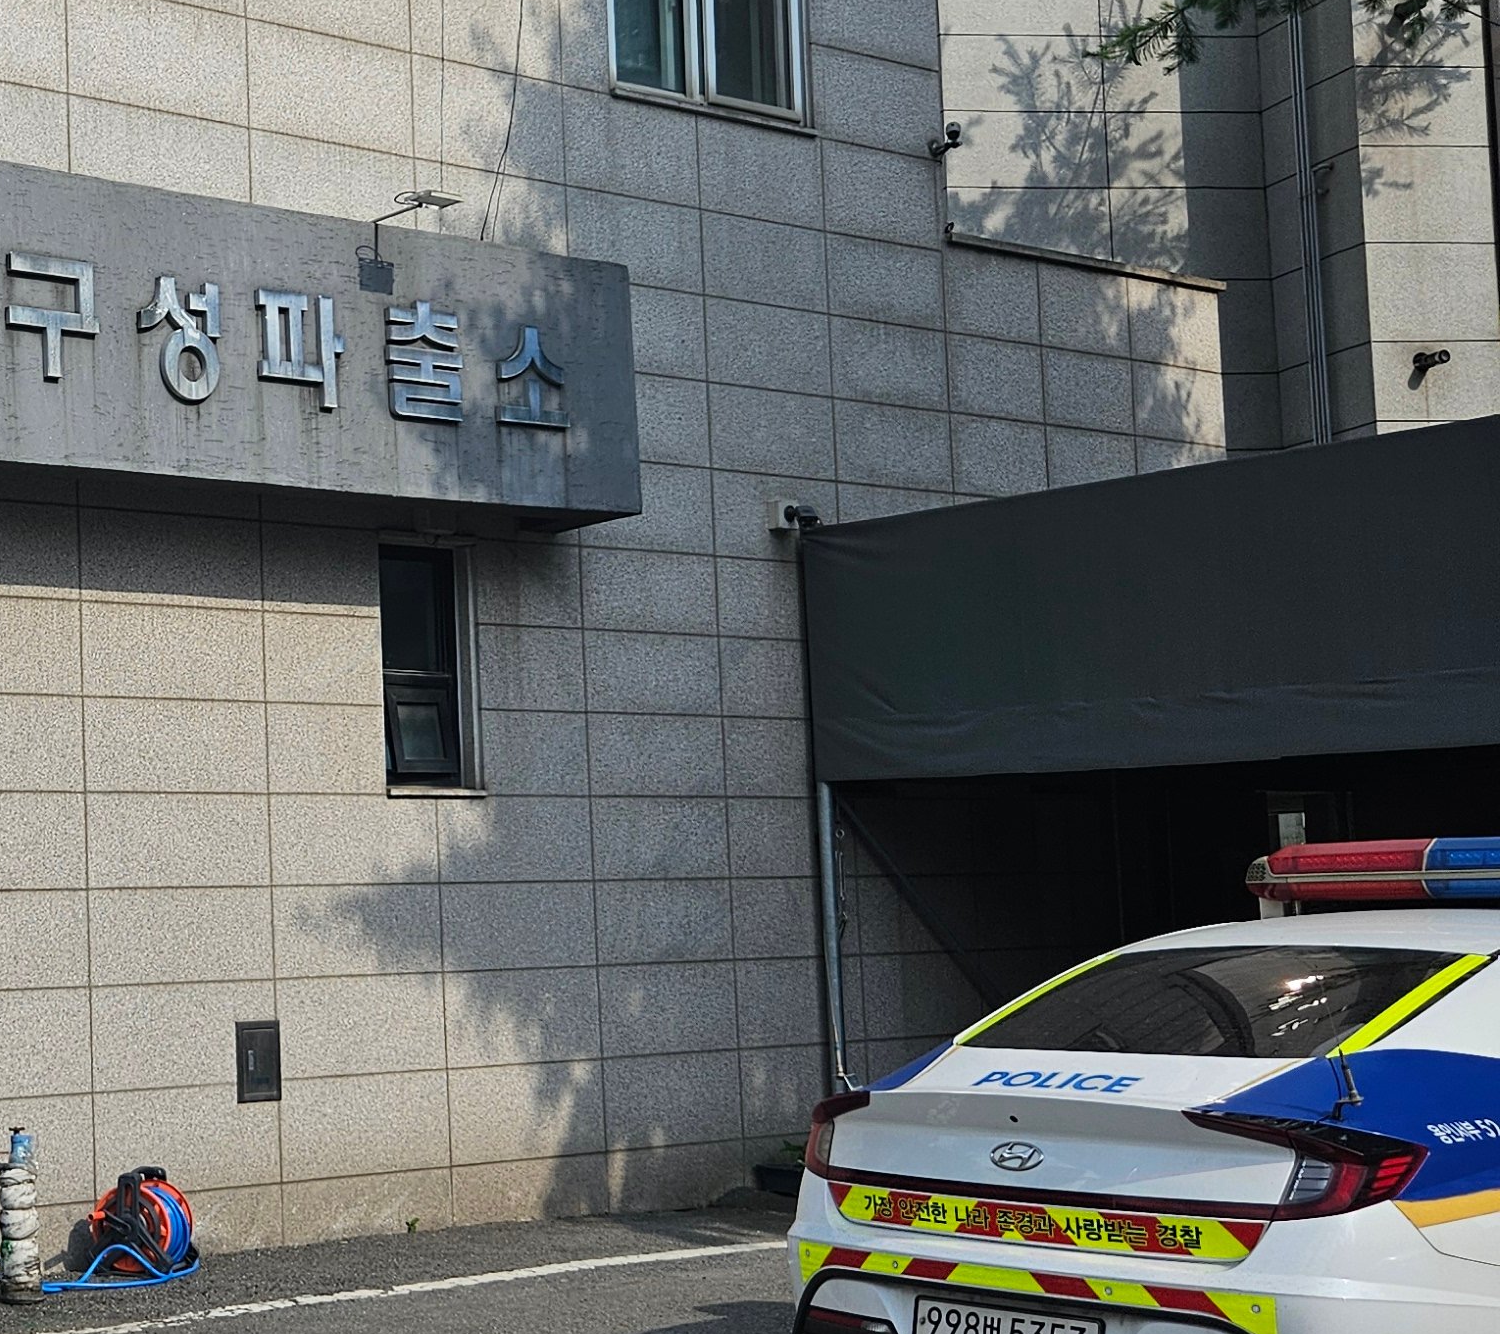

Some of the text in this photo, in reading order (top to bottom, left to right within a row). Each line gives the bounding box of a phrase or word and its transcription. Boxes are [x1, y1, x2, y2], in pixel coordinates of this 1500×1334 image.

[3, 249, 571, 431] 구성파출소
[972, 1070, 1143, 1094] POLICE
[1426, 1120, 1483, 1145] 용인서부
[864, 1194, 1203, 1250] 가장 안전한 나라 존경과 사랑받는 경찰
